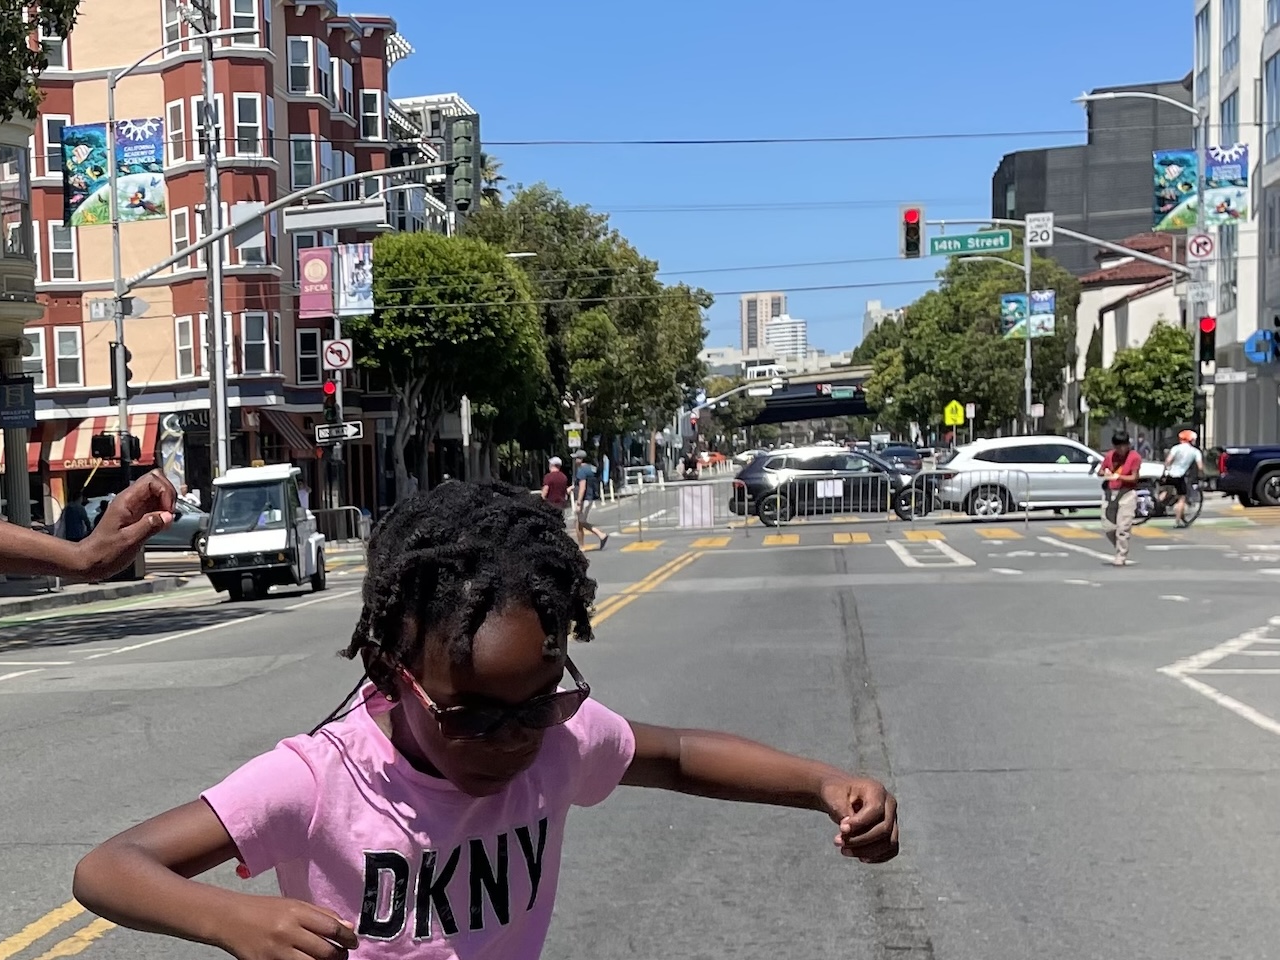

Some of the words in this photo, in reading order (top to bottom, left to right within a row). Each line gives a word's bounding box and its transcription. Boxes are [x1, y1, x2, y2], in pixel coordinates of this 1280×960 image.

[933, 239, 961, 252] 14th
[967, 234, 1005, 249] Street
[1029, 229, 1050, 243] 20
[304, 283, 329, 293] SFCM
[356, 816, 549, 942] DKNY
